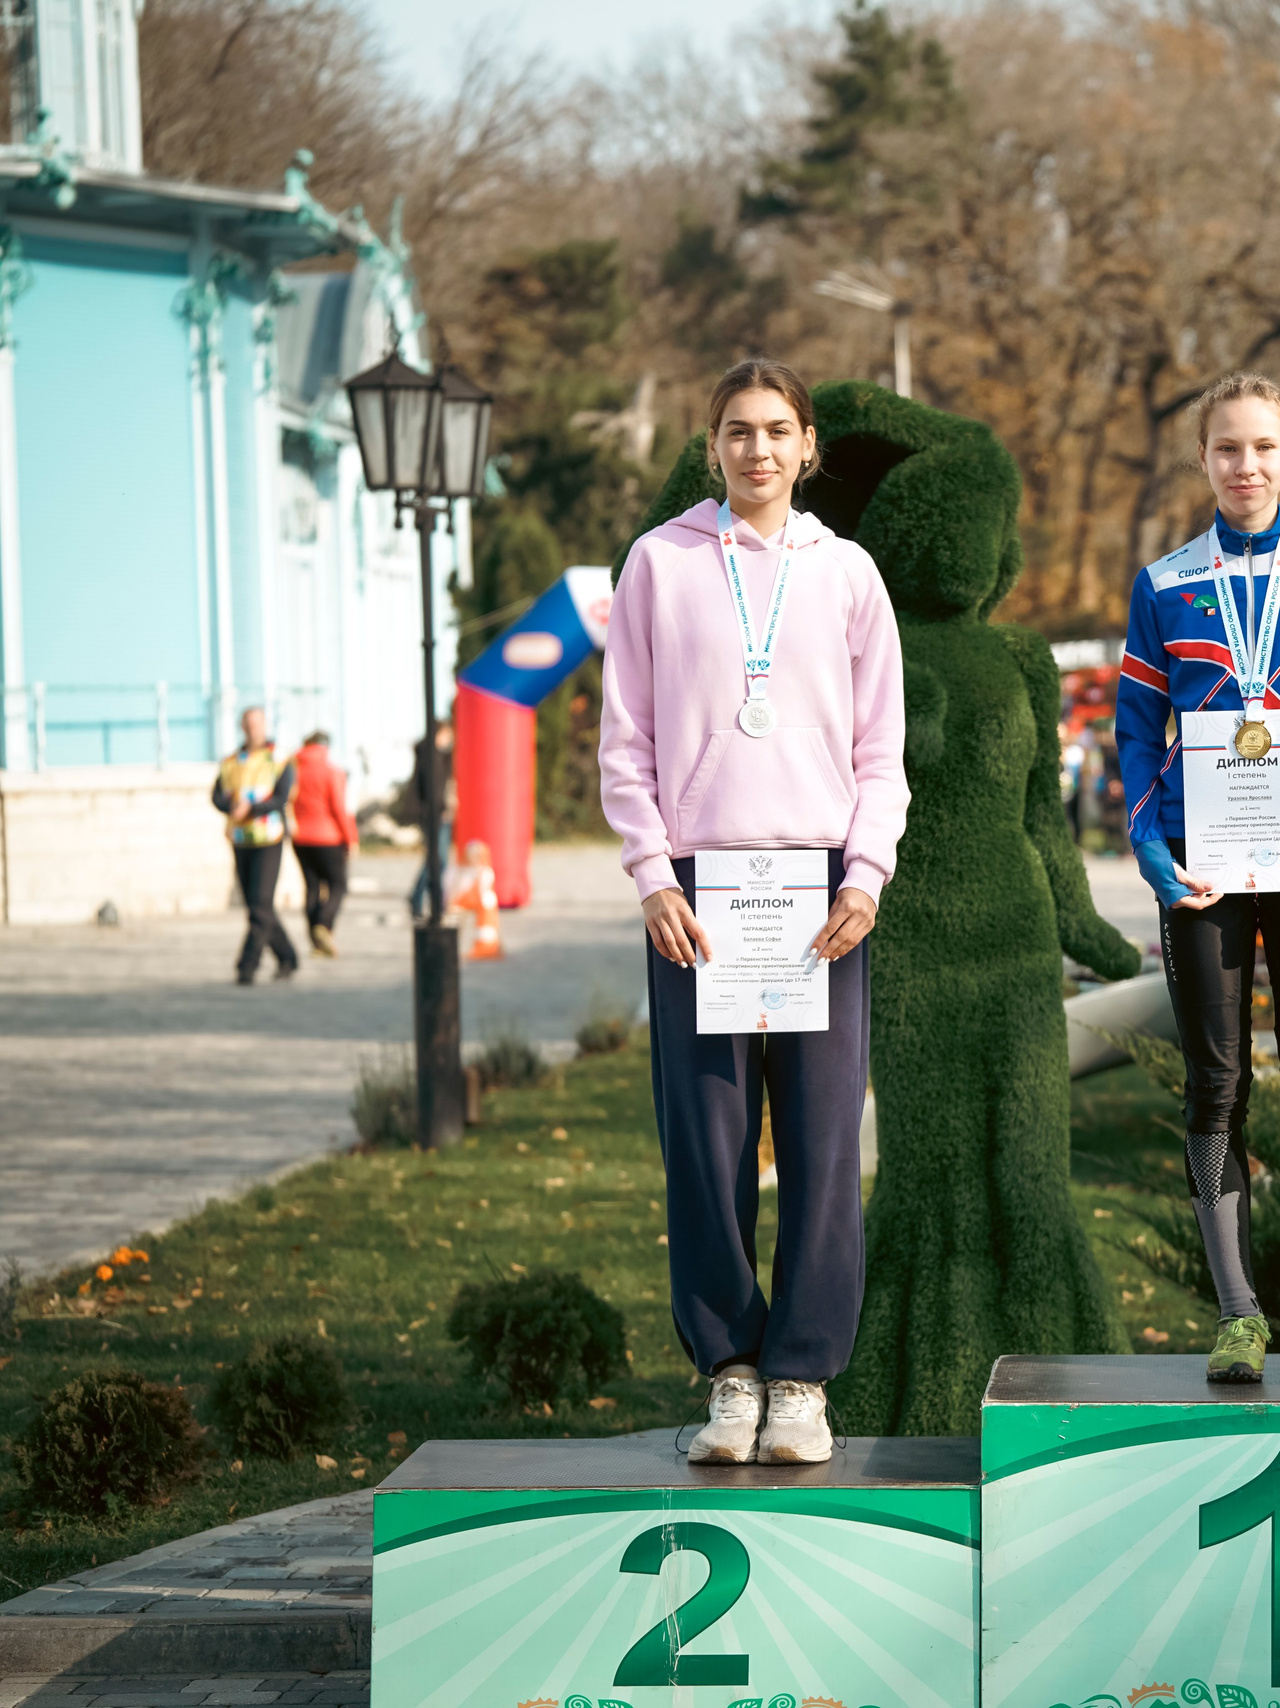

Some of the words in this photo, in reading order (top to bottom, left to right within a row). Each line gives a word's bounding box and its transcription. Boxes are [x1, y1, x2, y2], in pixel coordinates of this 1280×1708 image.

[729, 555, 742, 600] МИНИСТЕРСТВО
[739, 602, 747, 624] СПОРТА
[744, 626, 753, 652] РОССИИ
[1178, 566, 1209, 578] СШОР
[764, 607, 779, 652] МИНИСТЕРСТВО
[776, 584, 784, 605] СПОРТА
[1219, 578, 1233, 622] МИНИСТЕРСТВО
[1230, 624, 1240, 648] СПОРТА
[1236, 649, 1246, 675] РОССИИ
[1258, 626, 1270, 674] МИНИСТЕРСТВО
[1266, 601, 1275, 624] СПОРТА
[1272, 576, 1280, 599] РОССИИ
[1217, 757, 1278, 769] ДИПЛОМ
[730, 899, 793, 910] ДИПЛОМ
[612, 1523, 750, 1686] 2
